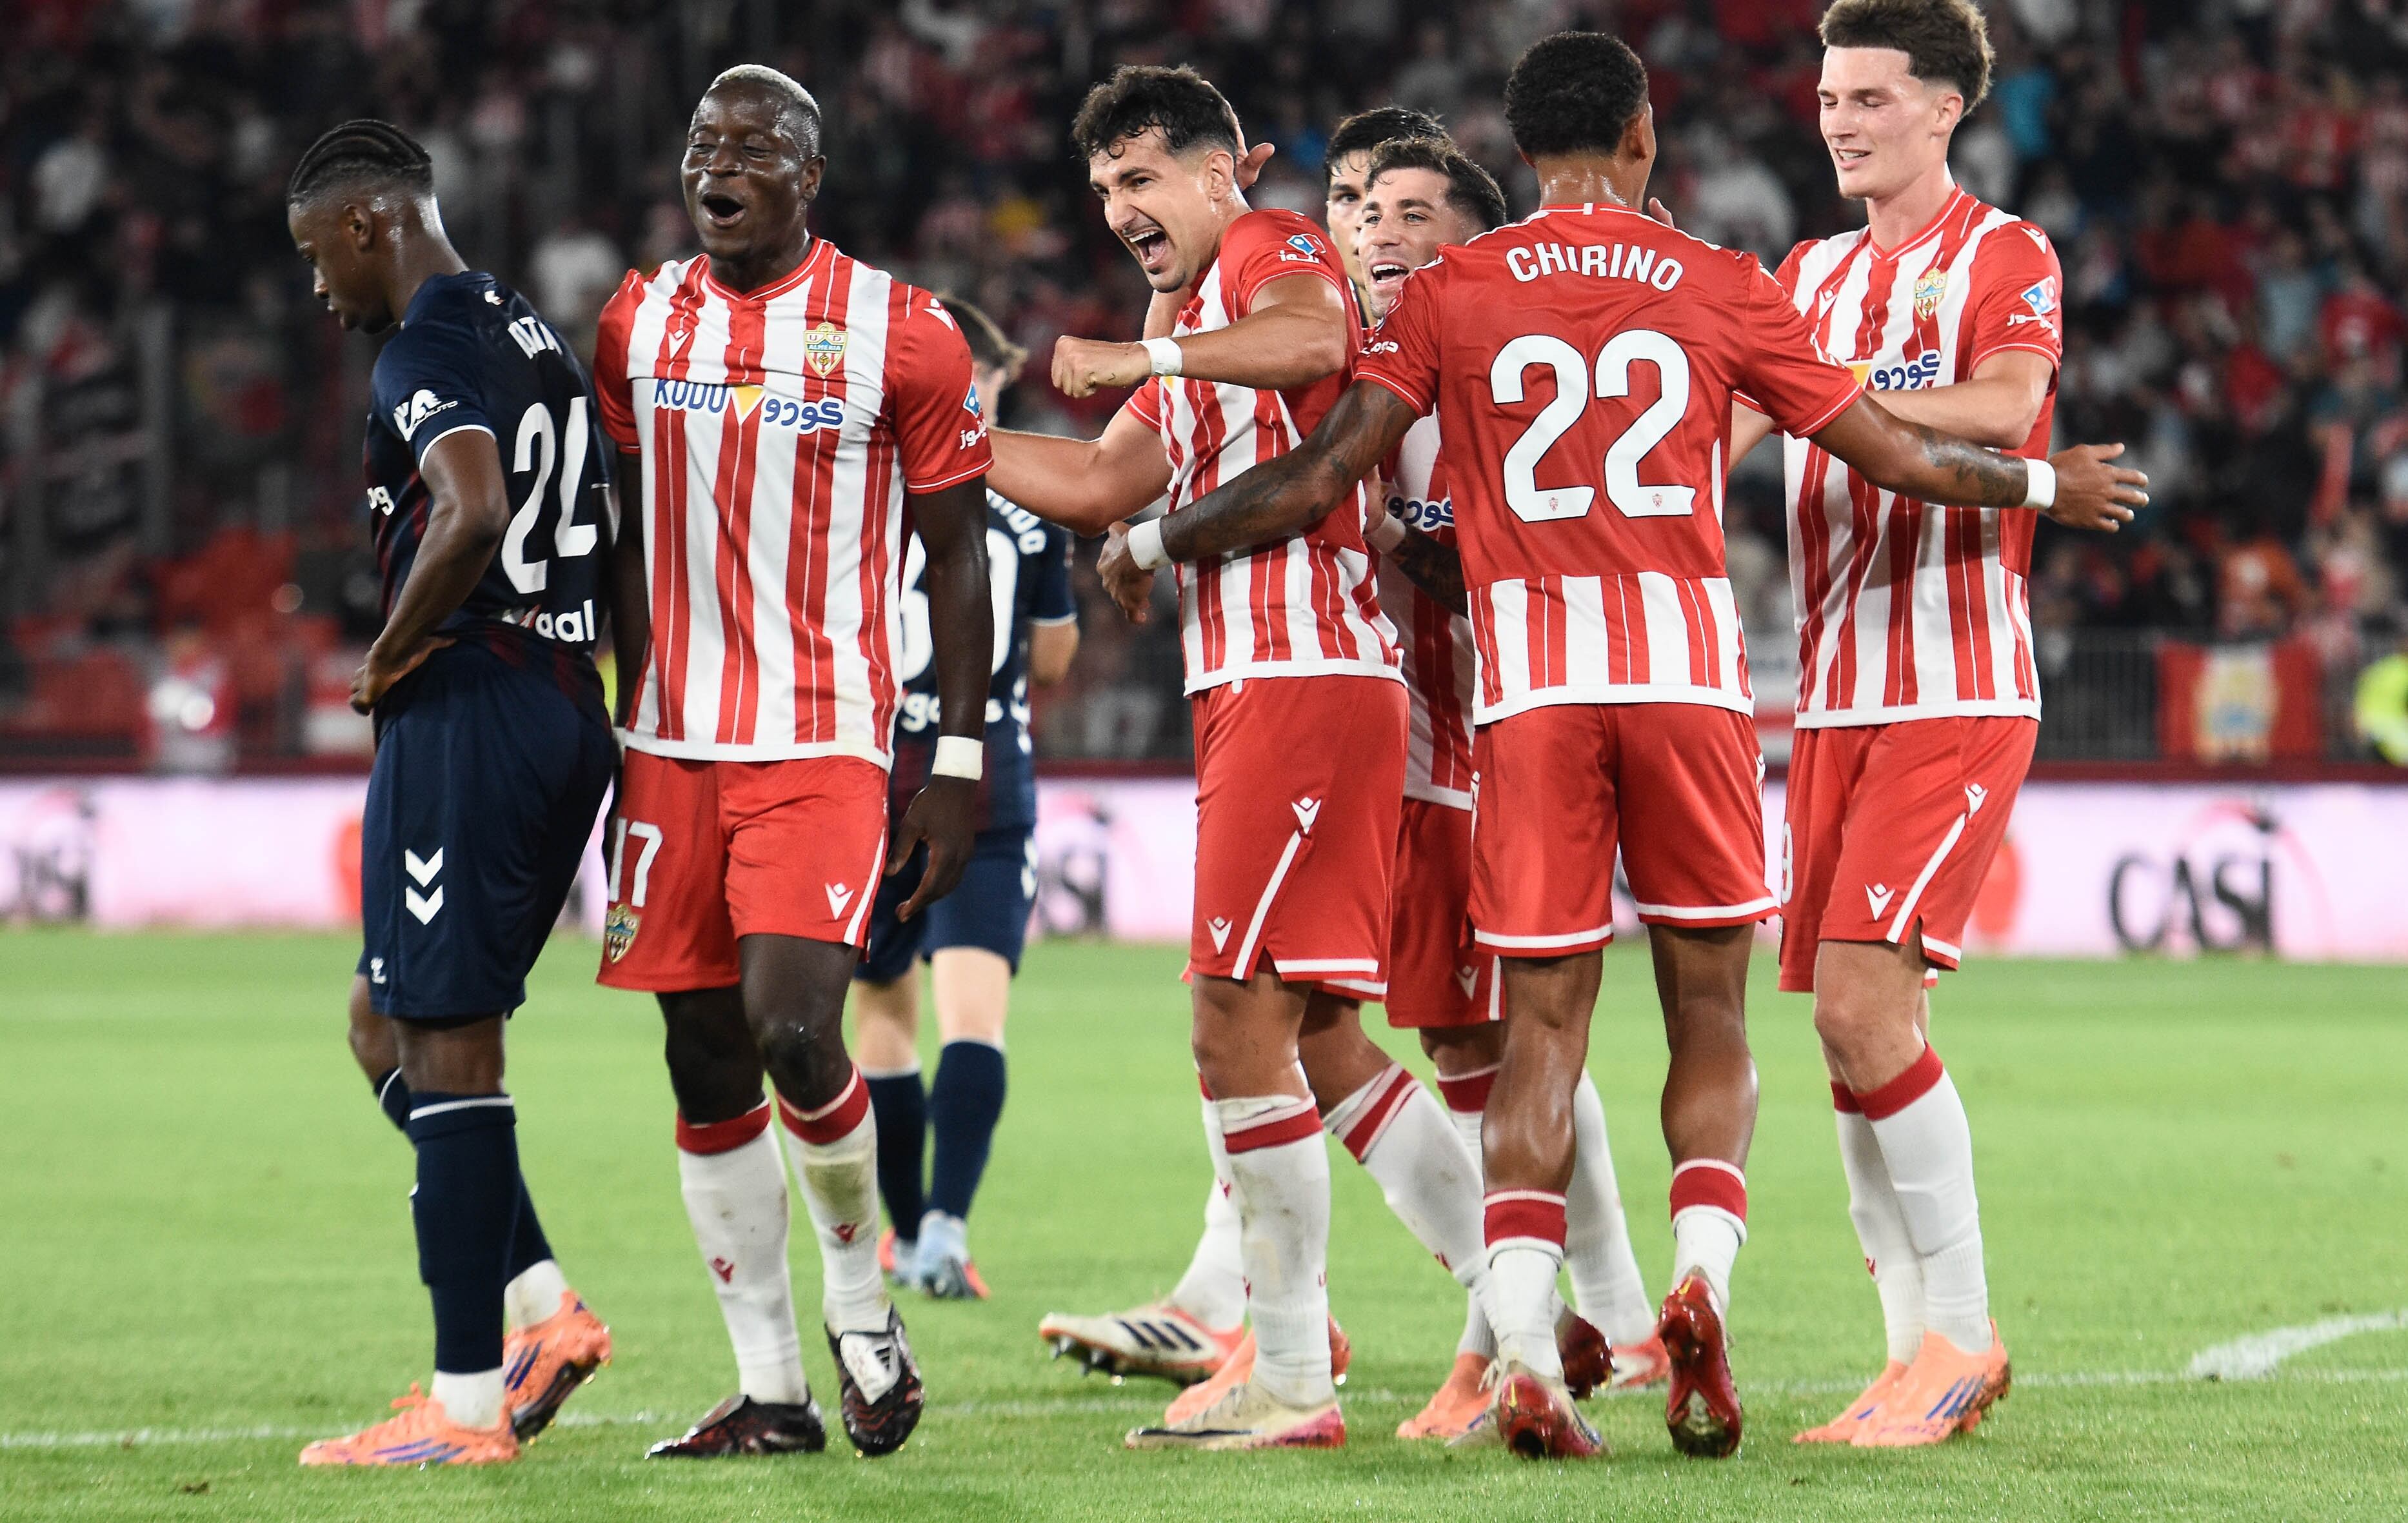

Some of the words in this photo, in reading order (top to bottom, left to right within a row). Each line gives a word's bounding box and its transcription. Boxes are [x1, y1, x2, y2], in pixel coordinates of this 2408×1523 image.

[1506, 242, 1684, 292] CHIRINO
[764, 398, 844, 430] كودو
[1489, 328, 1696, 523] 22
[608, 817, 663, 908] 17
